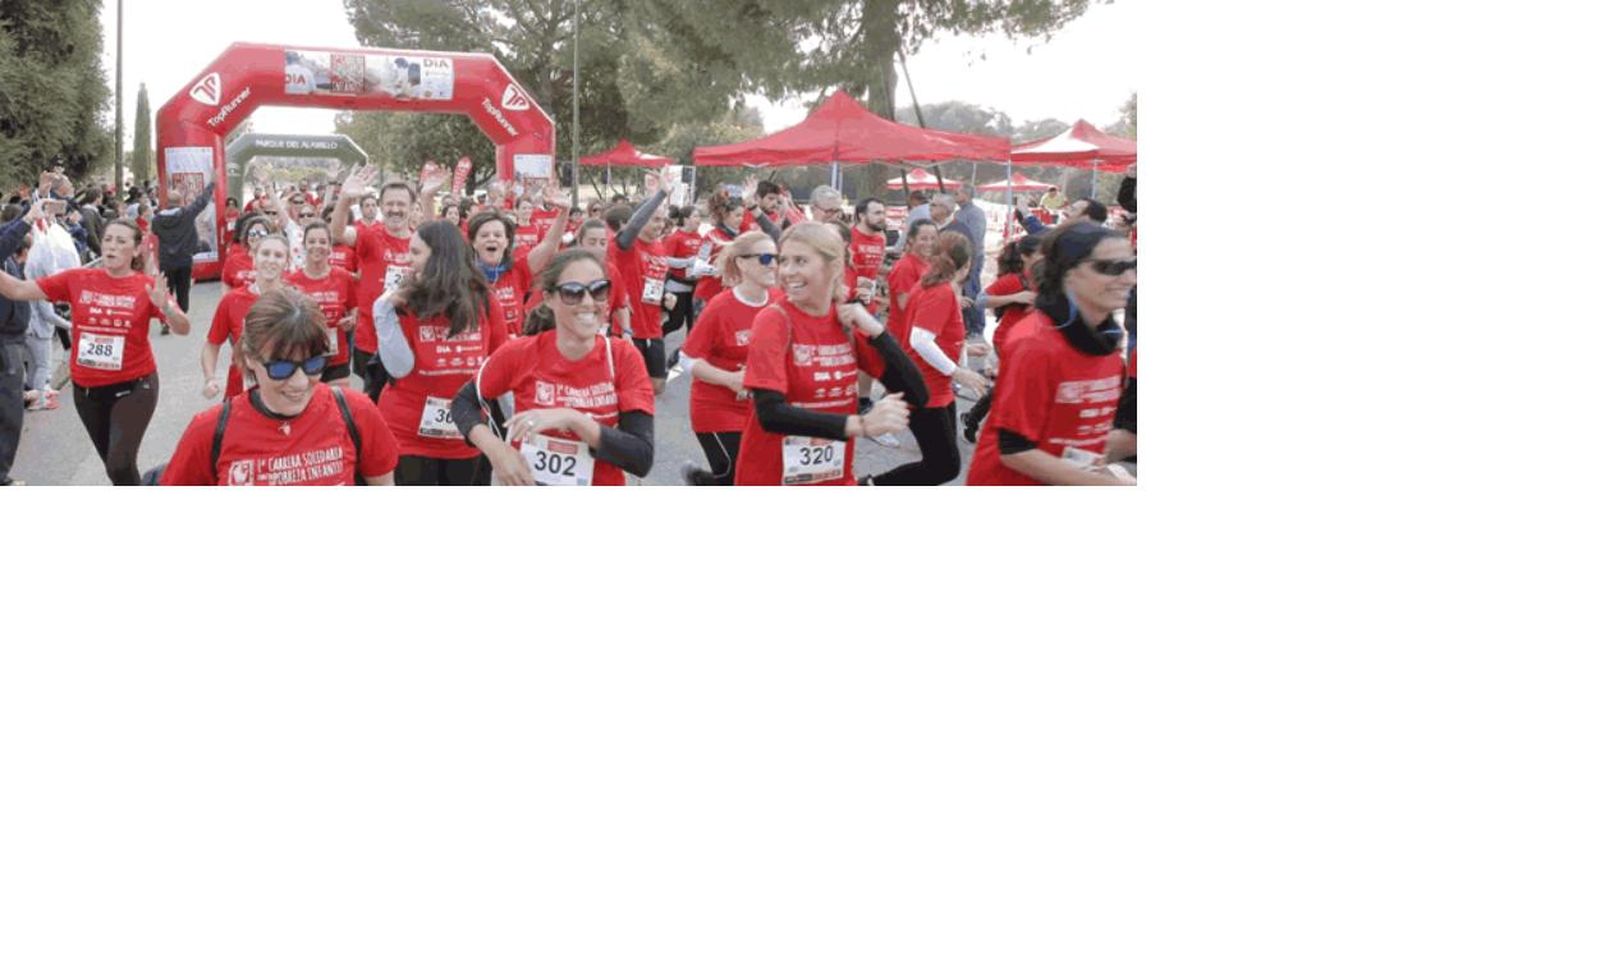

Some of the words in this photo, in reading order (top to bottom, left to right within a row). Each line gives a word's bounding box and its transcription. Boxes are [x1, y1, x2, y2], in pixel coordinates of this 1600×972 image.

[207, 86, 251, 127] TopRunner
[481, 97, 519, 137] TopRunner
[88, 342, 113, 357] 288
[534, 450, 577, 477] 302
[800, 445, 834, 465] 320
